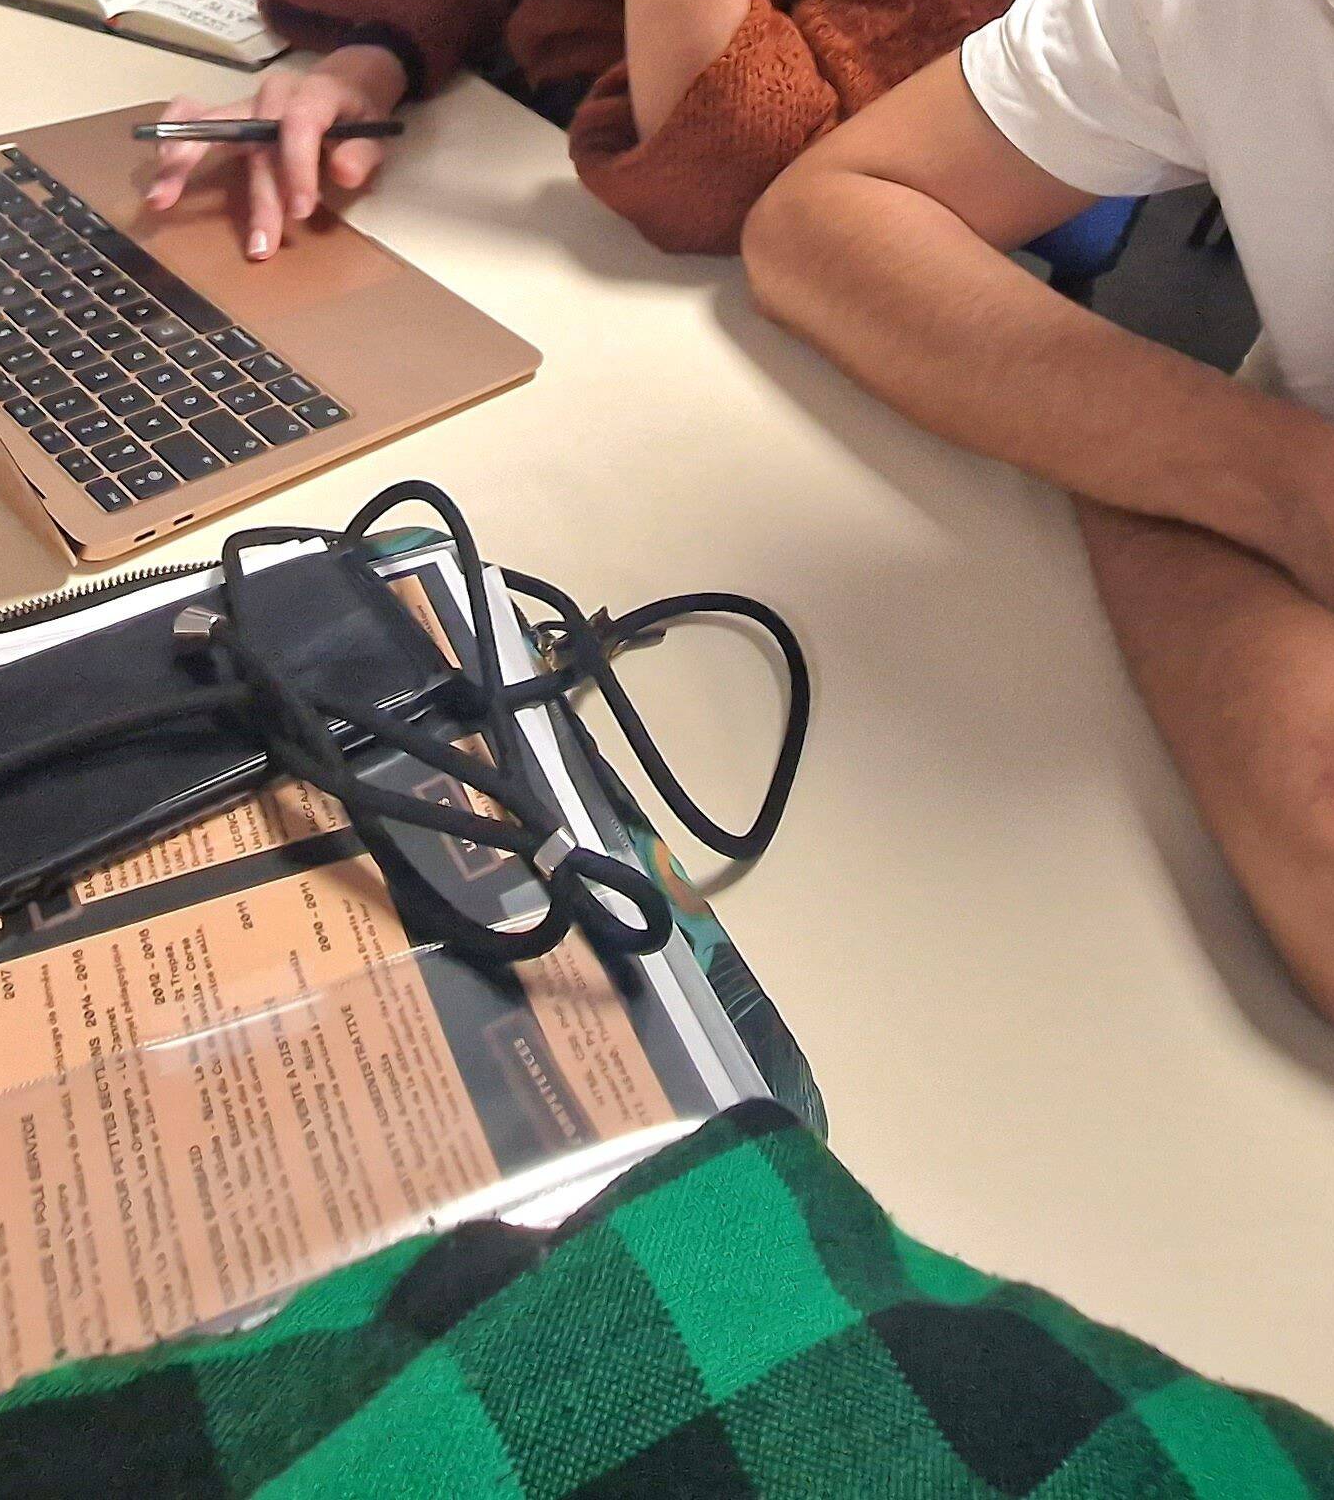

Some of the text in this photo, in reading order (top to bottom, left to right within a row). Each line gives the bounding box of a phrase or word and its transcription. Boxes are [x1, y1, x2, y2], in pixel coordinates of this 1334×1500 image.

[298, 880, 317, 909] 2011
[235, 899, 253, 929] 2011
[180, 936, 196, 971] Corse
[312, 920, 331, 952] 2010
[0, 967, 15, 1000] 2017
[37, 962, 56, 1008] données
[109, 942, 134, 1014] pédagogique
[147, 971, 166, 1006] 2012
[172, 987, 184, 1002] St
[79, 993, 97, 1029] 2014
[19, 1112, 42, 1182] SERVICE
